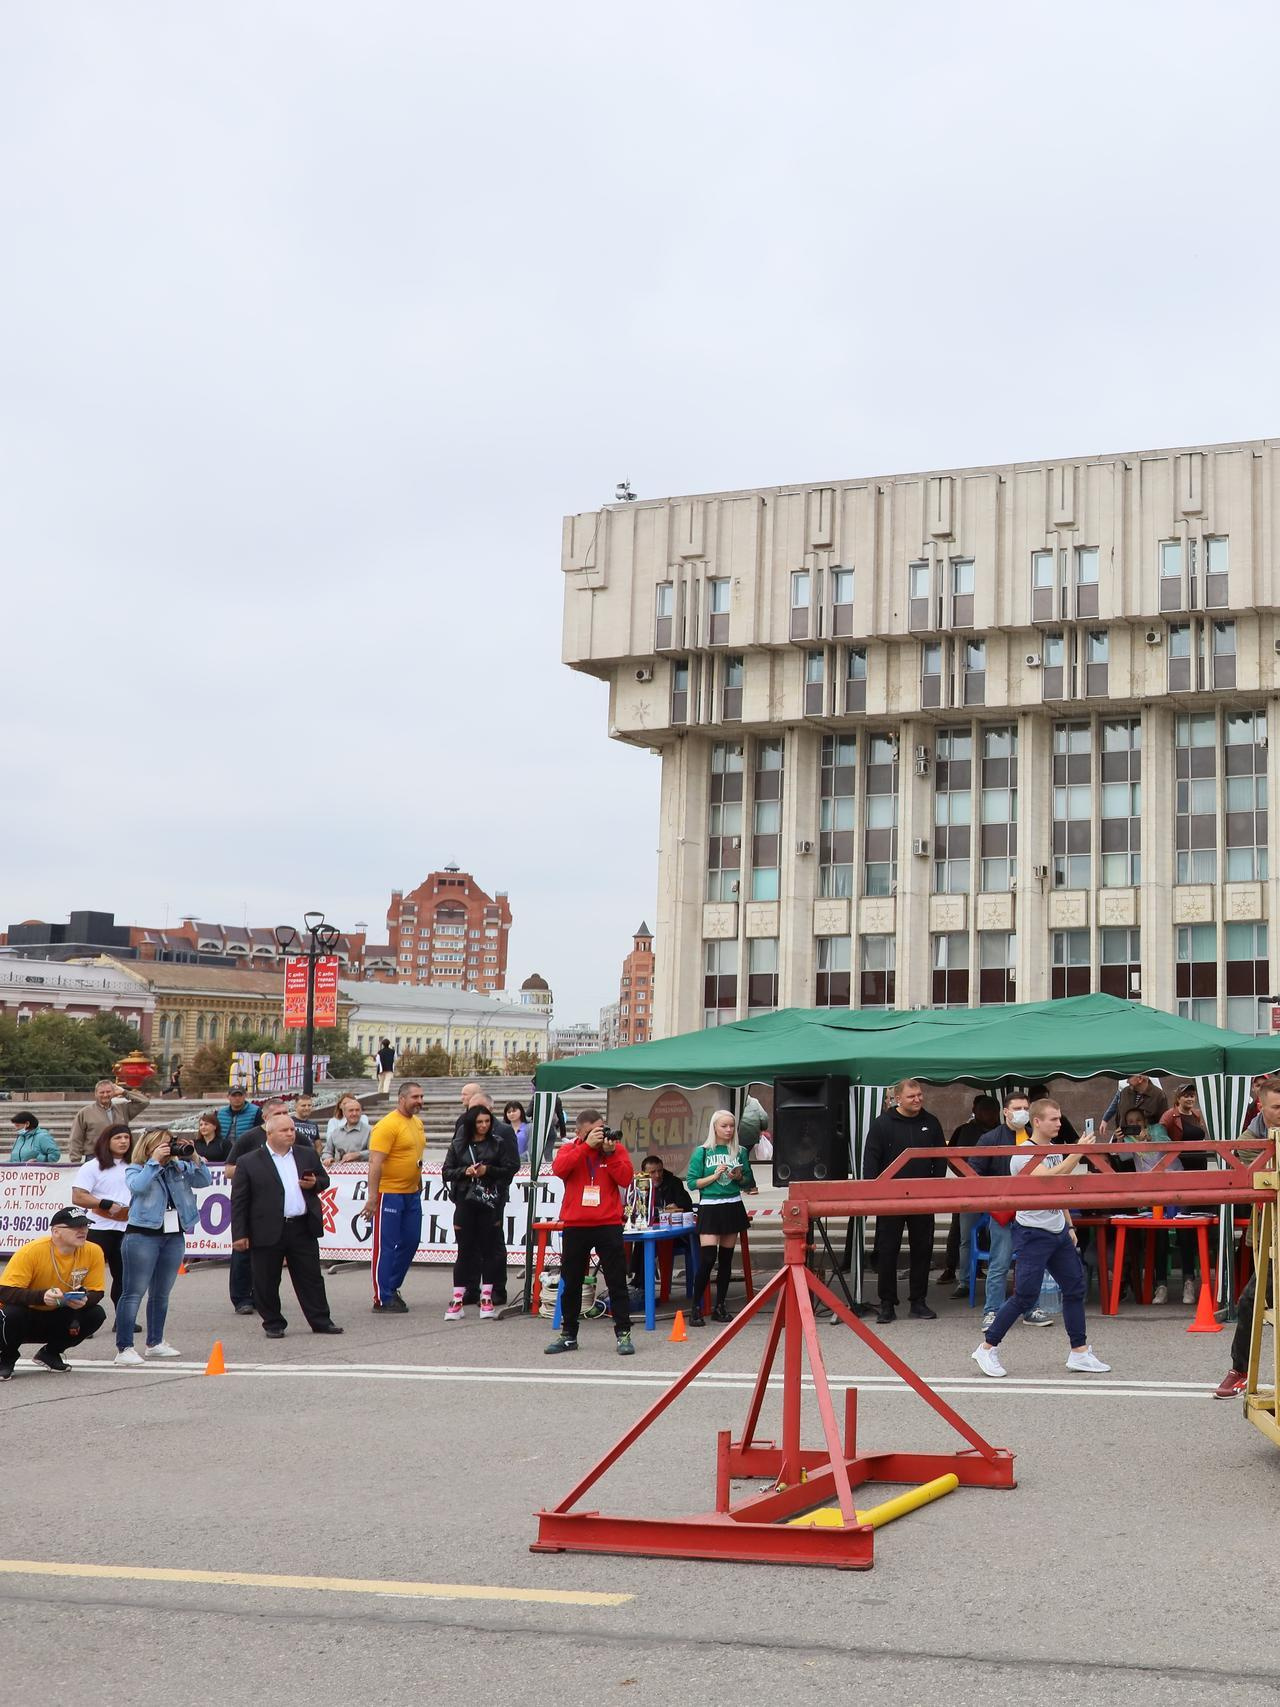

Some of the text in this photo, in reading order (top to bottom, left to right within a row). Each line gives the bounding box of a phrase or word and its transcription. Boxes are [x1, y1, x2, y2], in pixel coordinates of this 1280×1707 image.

[20, 1172, 60, 1183] метров
[4, 1185, 47, 1196] от ТГПУ
[25, 1200, 64, 1210] Толстого
